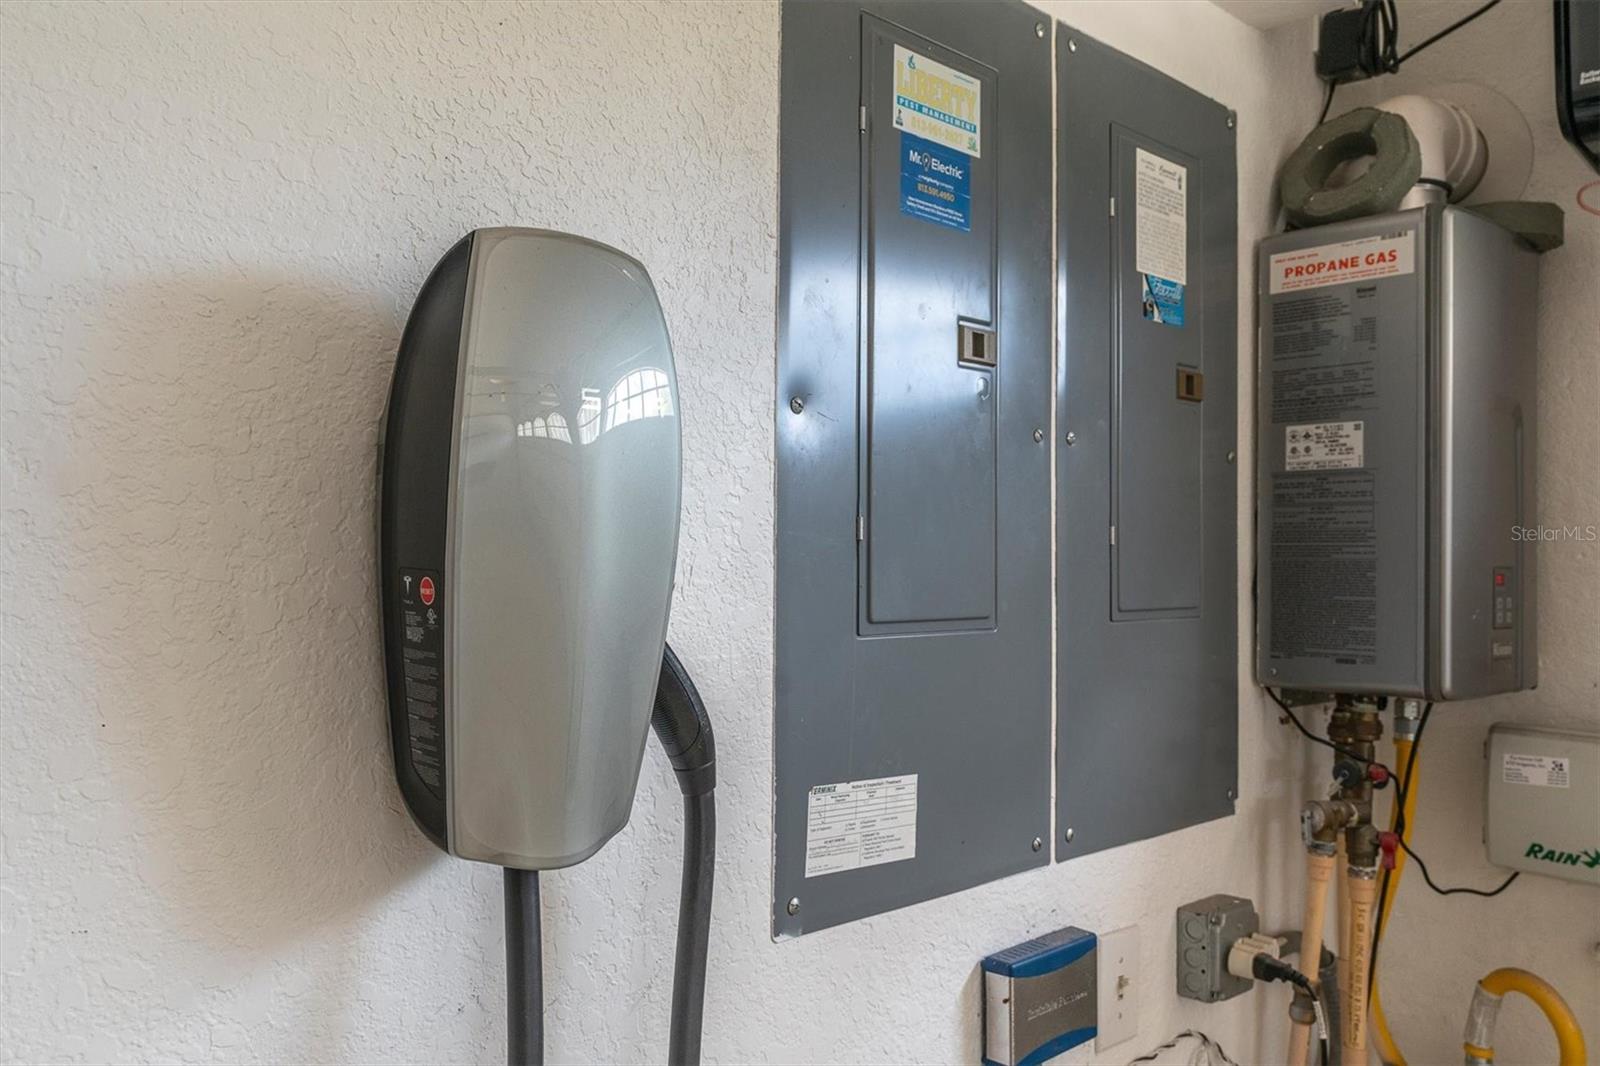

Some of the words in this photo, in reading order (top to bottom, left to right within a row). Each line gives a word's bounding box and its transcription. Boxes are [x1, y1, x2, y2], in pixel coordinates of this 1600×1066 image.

[896, 60, 977, 120] LIBERTY
[899, 97, 919, 109] PEST
[921, 105, 975, 131] MANAGEMENT
[931, 158, 963, 179] Electric
[1284, 255, 1360, 278] PROPANE
[1365, 249, 1398, 265] GAS
[1524, 843, 1581, 866] RAIN
